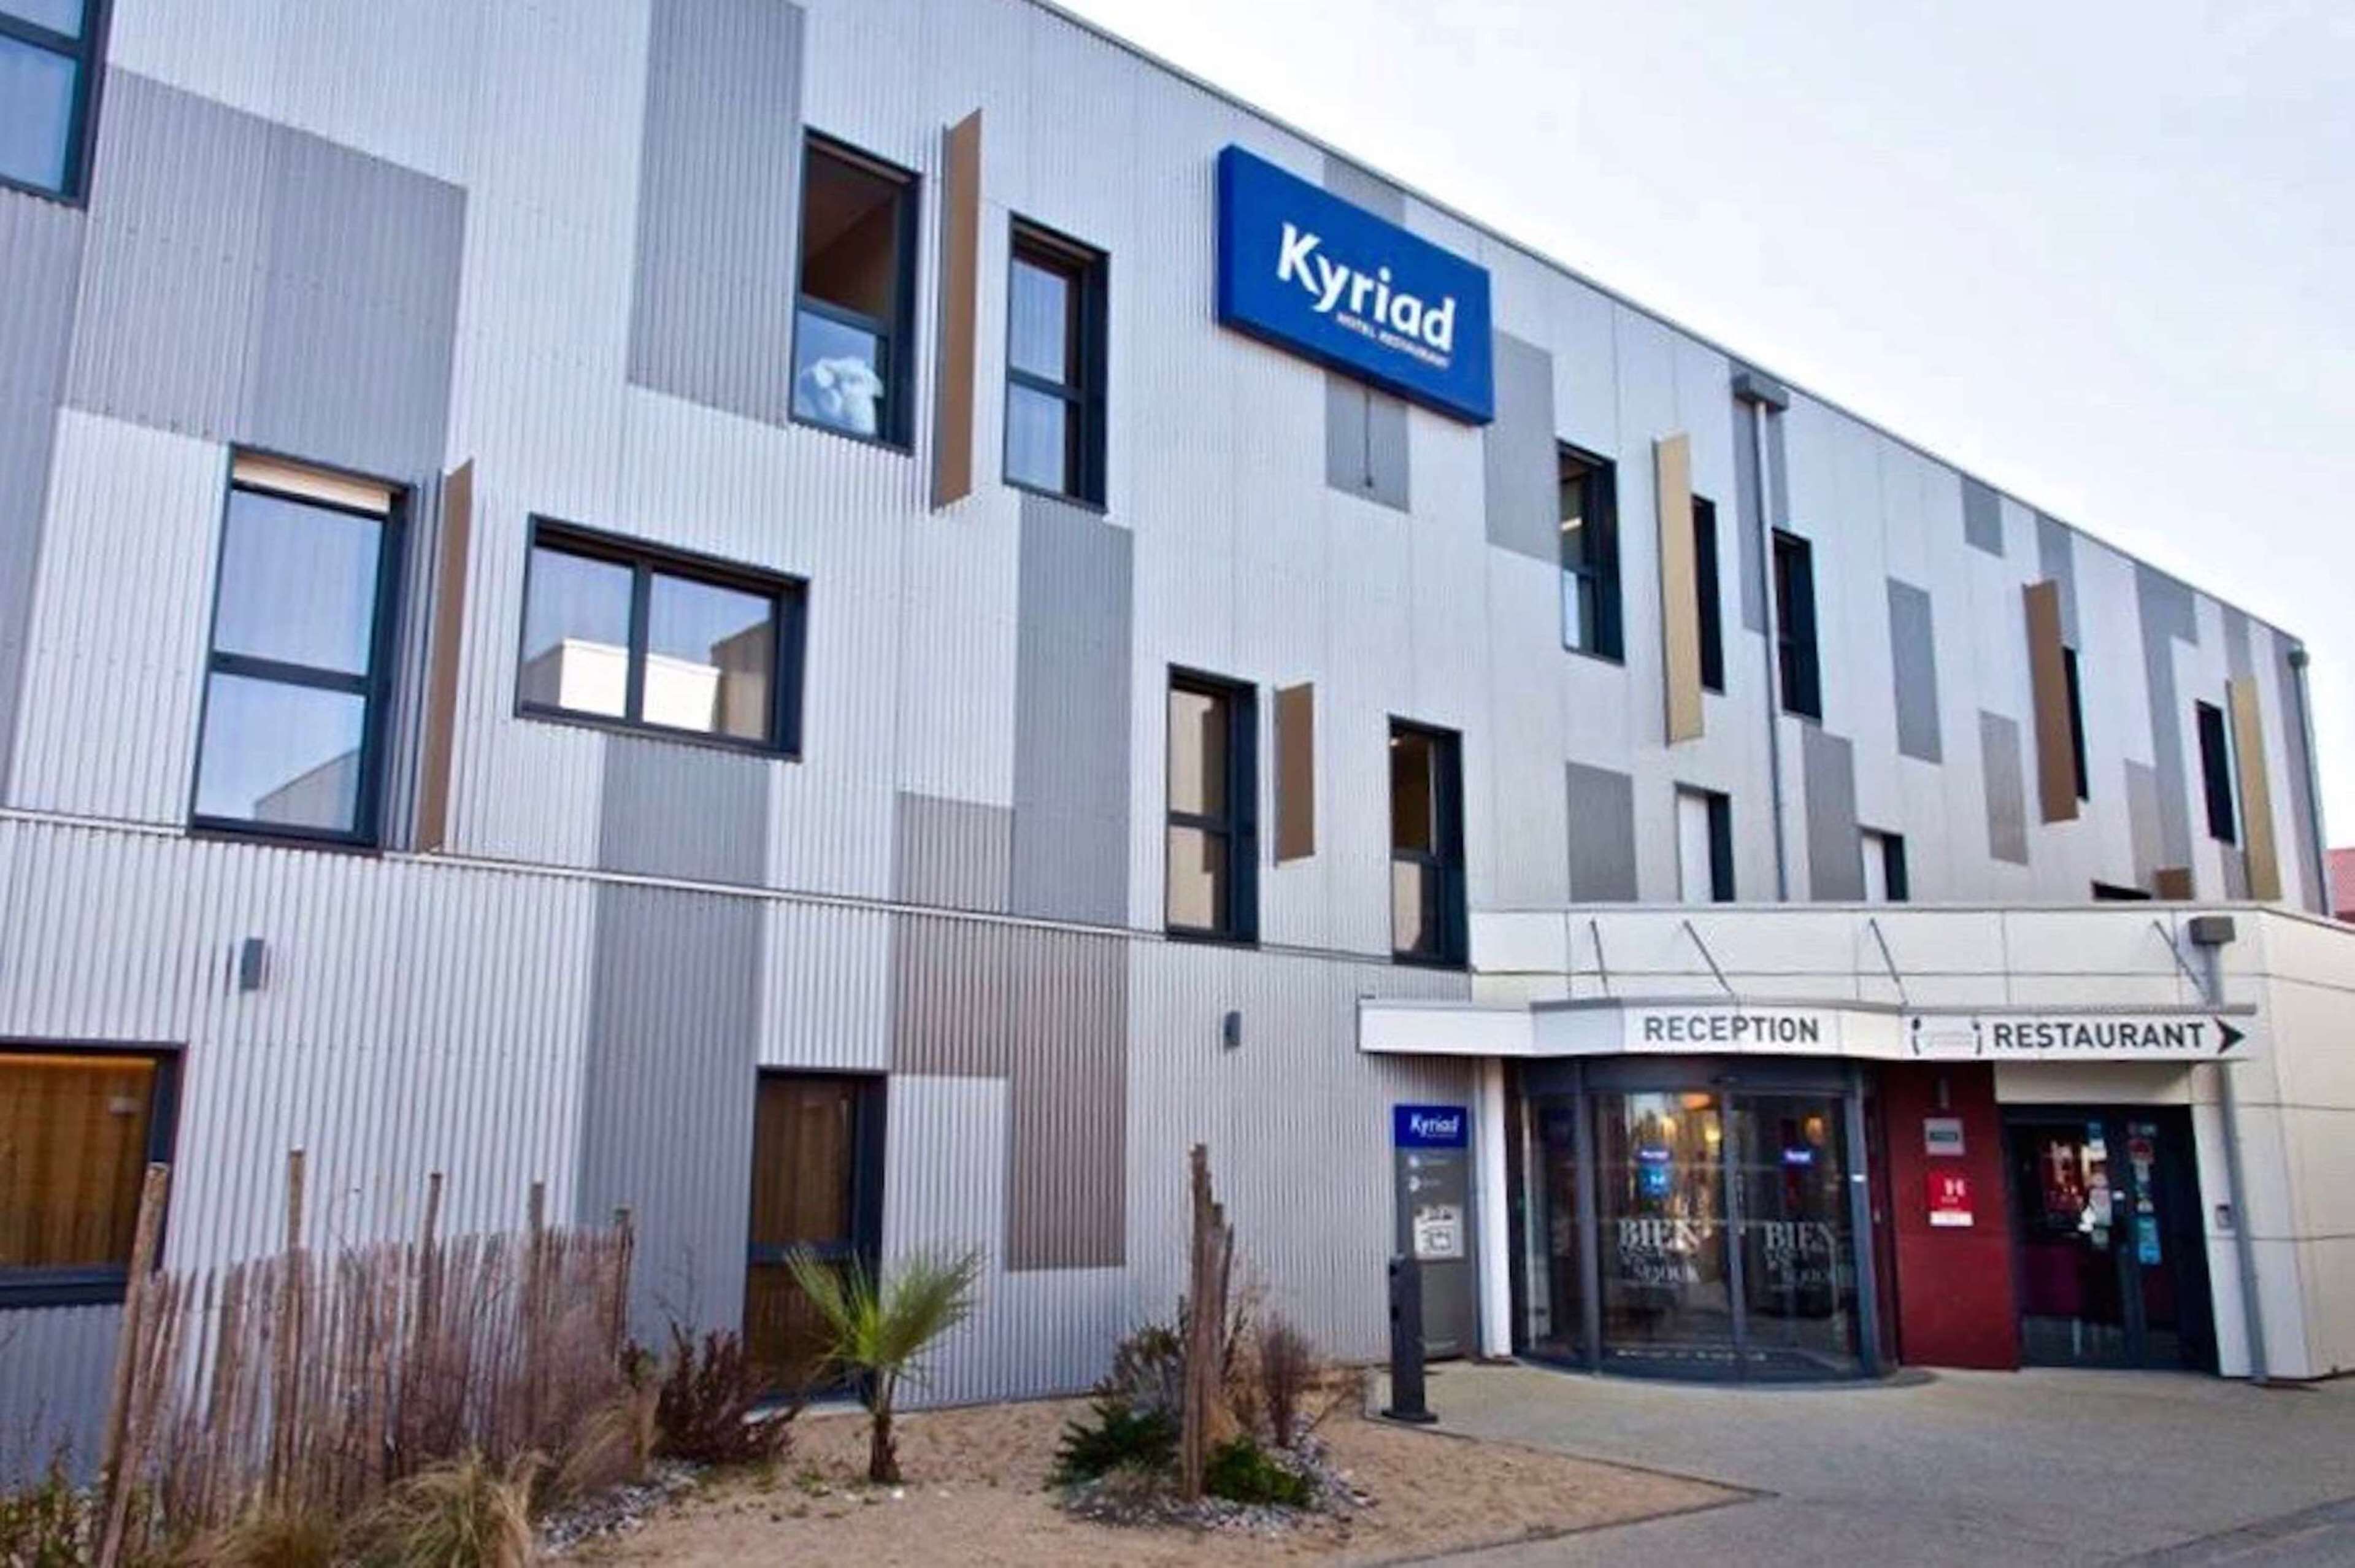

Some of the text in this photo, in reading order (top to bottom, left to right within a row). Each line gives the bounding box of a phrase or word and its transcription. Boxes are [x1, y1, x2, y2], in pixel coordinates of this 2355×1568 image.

[1276, 221, 1456, 352] Kyriad
[1643, 1016, 1818, 1043] RECEPTION
[1994, 1022, 2205, 1049] RESTAURANT
[1410, 1113, 1460, 1138] Kyriad
